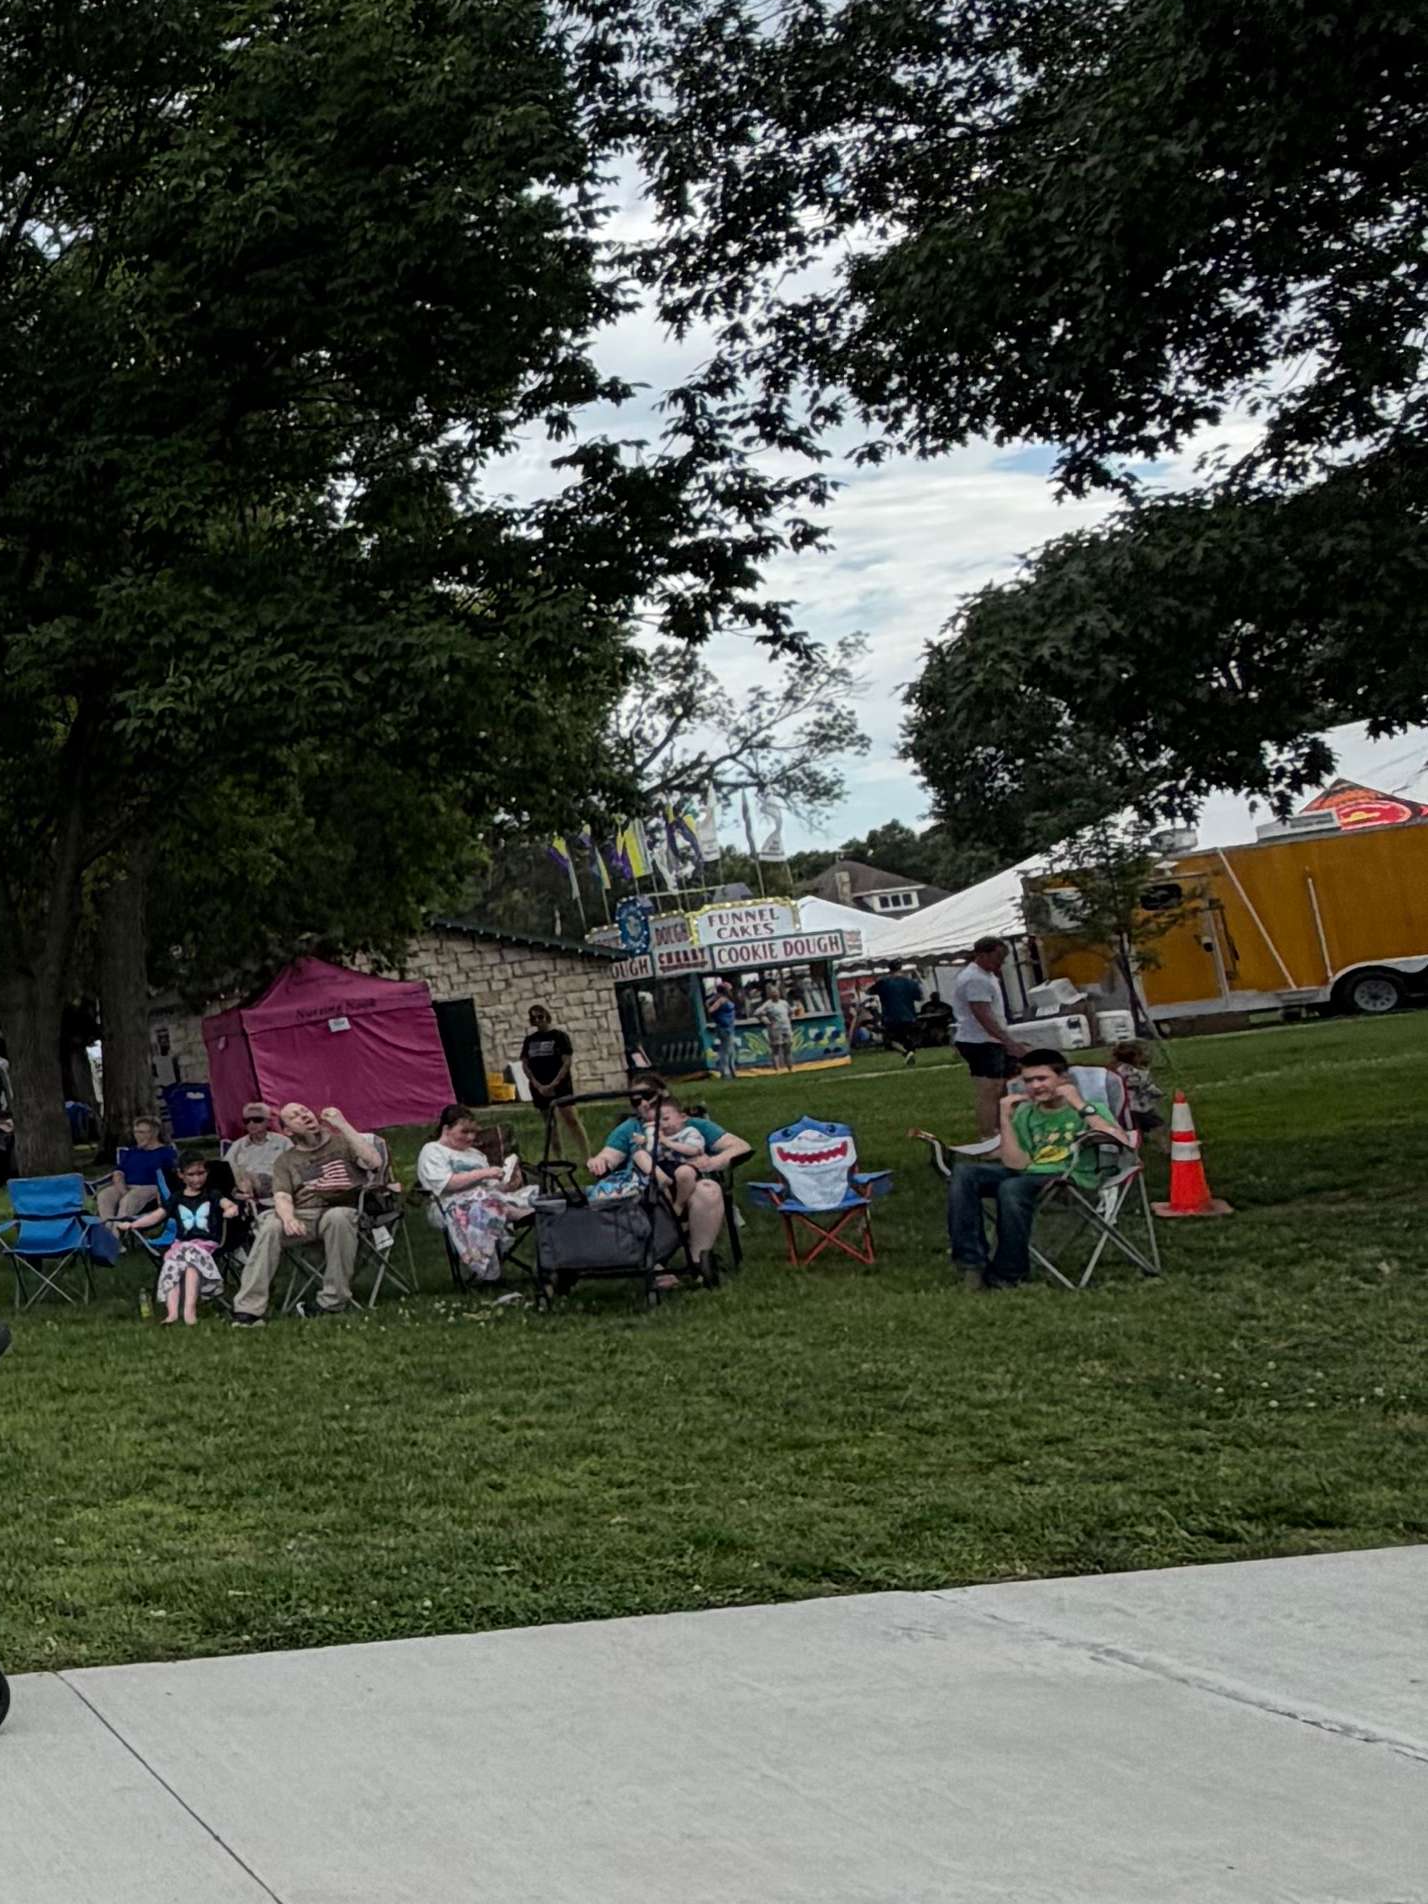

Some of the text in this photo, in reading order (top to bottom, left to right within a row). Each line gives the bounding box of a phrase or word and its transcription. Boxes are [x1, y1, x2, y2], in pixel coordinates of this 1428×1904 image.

[708, 908, 780, 928] FUNNEL
[716, 922, 774, 940] CAKES
[717, 941, 778, 965] COOKIE
[782, 934, 840, 957] DOUGH
[610, 959, 649, 980] OUGH
